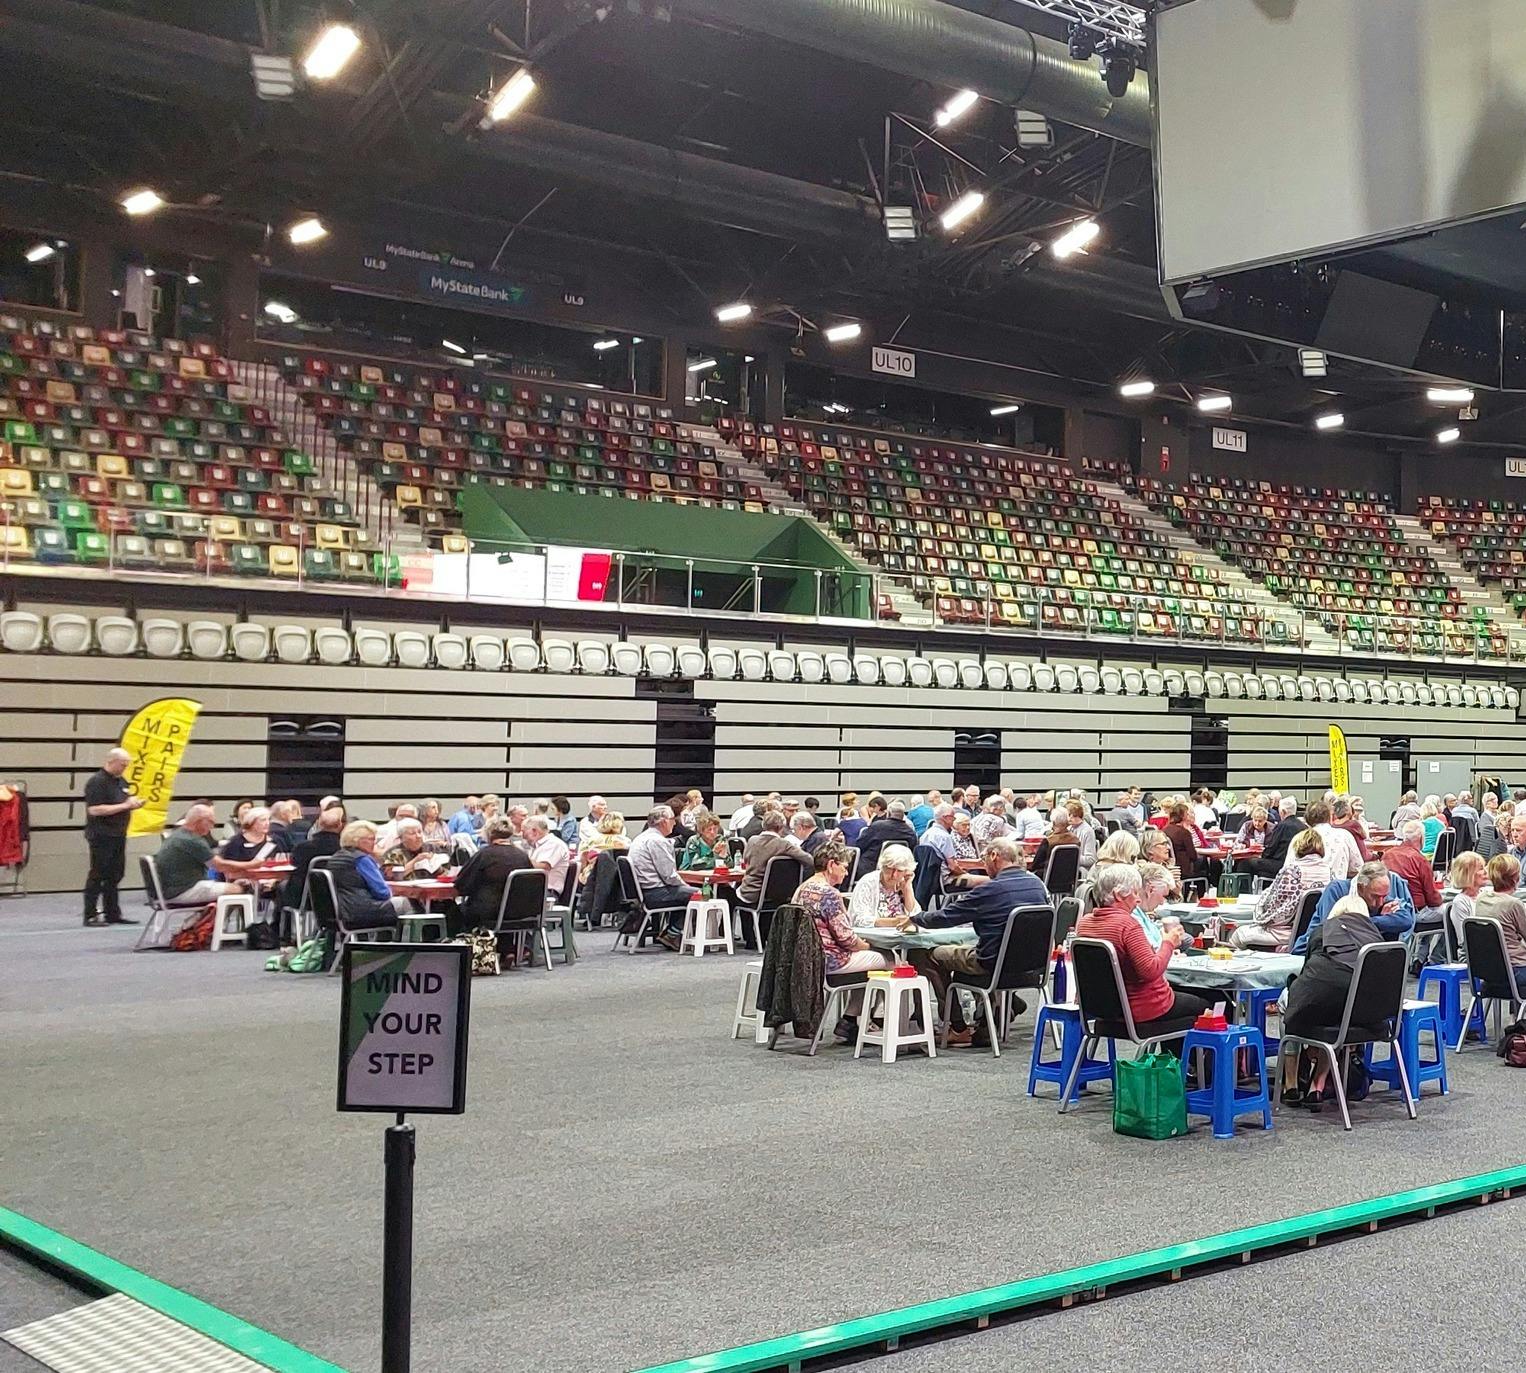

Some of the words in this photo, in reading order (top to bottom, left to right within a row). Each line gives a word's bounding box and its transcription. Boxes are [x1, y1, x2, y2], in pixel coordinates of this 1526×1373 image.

[430, 276, 509, 301] MyStateBank
[875, 351, 912, 372] UL10
[1217, 431, 1243, 447] UL11
[128, 718, 161, 797] MIXED
[148, 724, 180, 803] PAIRS
[366, 973, 443, 994] MIND
[363, 1012, 442, 1034] YOUR
[367, 1052, 434, 1075] STEP
